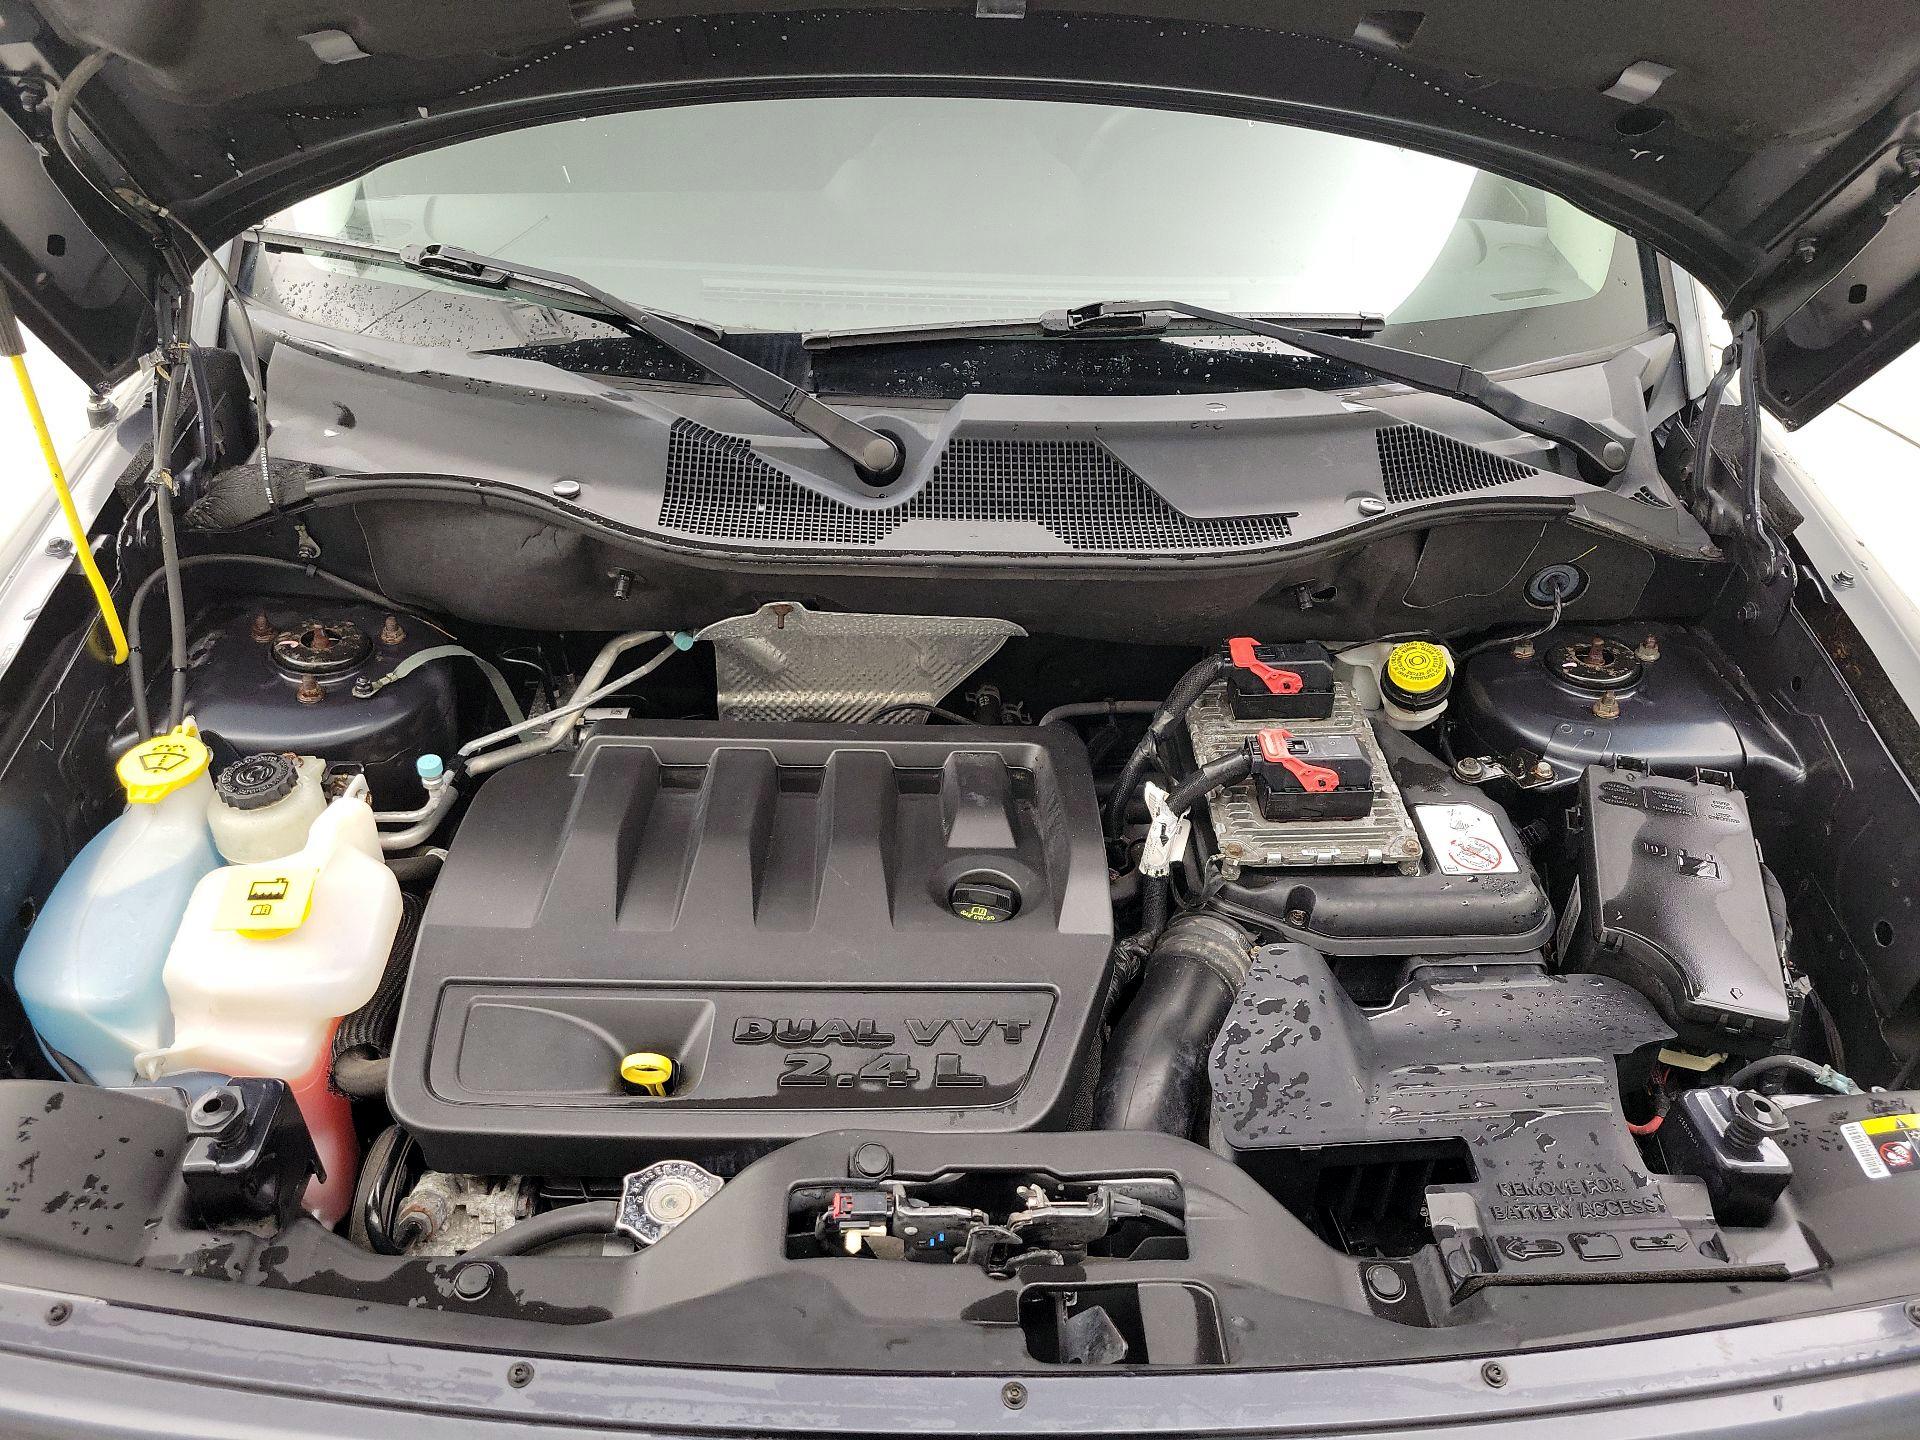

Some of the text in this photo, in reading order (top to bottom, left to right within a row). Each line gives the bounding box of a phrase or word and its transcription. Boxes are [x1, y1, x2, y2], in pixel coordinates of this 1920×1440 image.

[732, 1016, 1031, 1045] DUAL VVT
[1497, 1177, 1626, 1197] REMOVE FOR
[1490, 1197, 1659, 1220] BATTERY ACCESS
